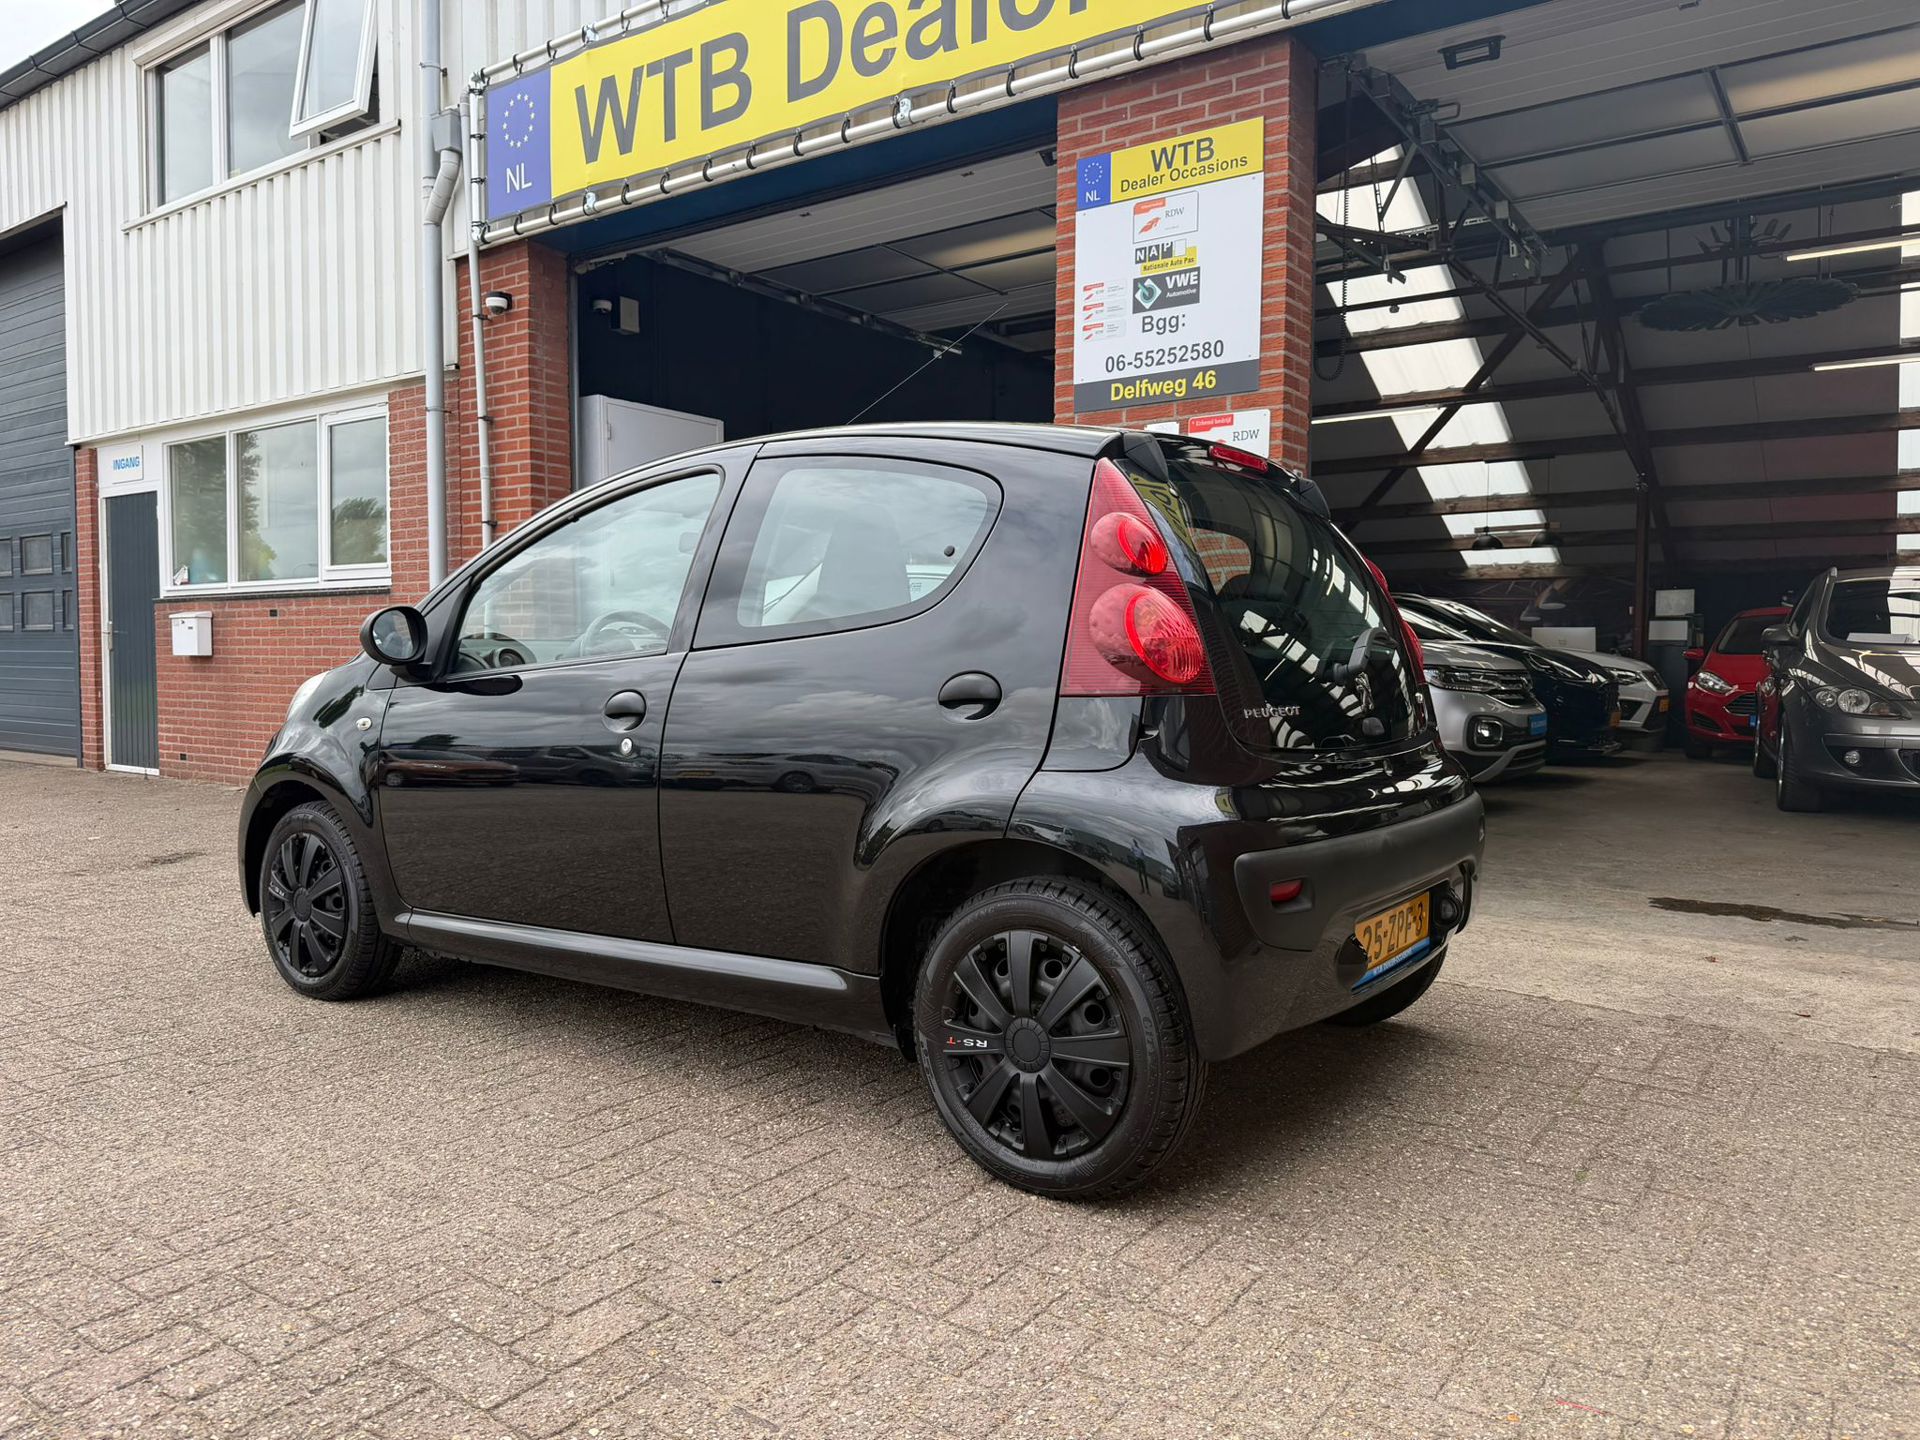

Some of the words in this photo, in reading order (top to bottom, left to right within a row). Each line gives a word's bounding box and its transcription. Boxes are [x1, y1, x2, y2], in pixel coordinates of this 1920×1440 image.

[574, 32, 752, 164] WTB
[787, 0, 1088, 103] Dea
[1151, 137, 1214, 172] WTB
[506, 162, 532, 193] NL
[1120, 173, 1165, 193] Dealer
[1170, 155, 1248, 181] Occasions
[1085, 190, 1101, 203] NL
[1164, 207, 1185, 218] RDW
[1136, 241, 1172, 262] NAP
[1165, 271, 1199, 289] VWE
[1141, 314, 1186, 335] Bgg:
[1105, 339, 1224, 373] 06-55252580
[1111, 377, 1187, 401] Delfweg
[1192, 370, 1217, 390] 46
[1232, 428, 1260, 442] RDW
[112, 456, 140, 471] INGANG
[1243, 705, 1301, 719] PEUGEOT
